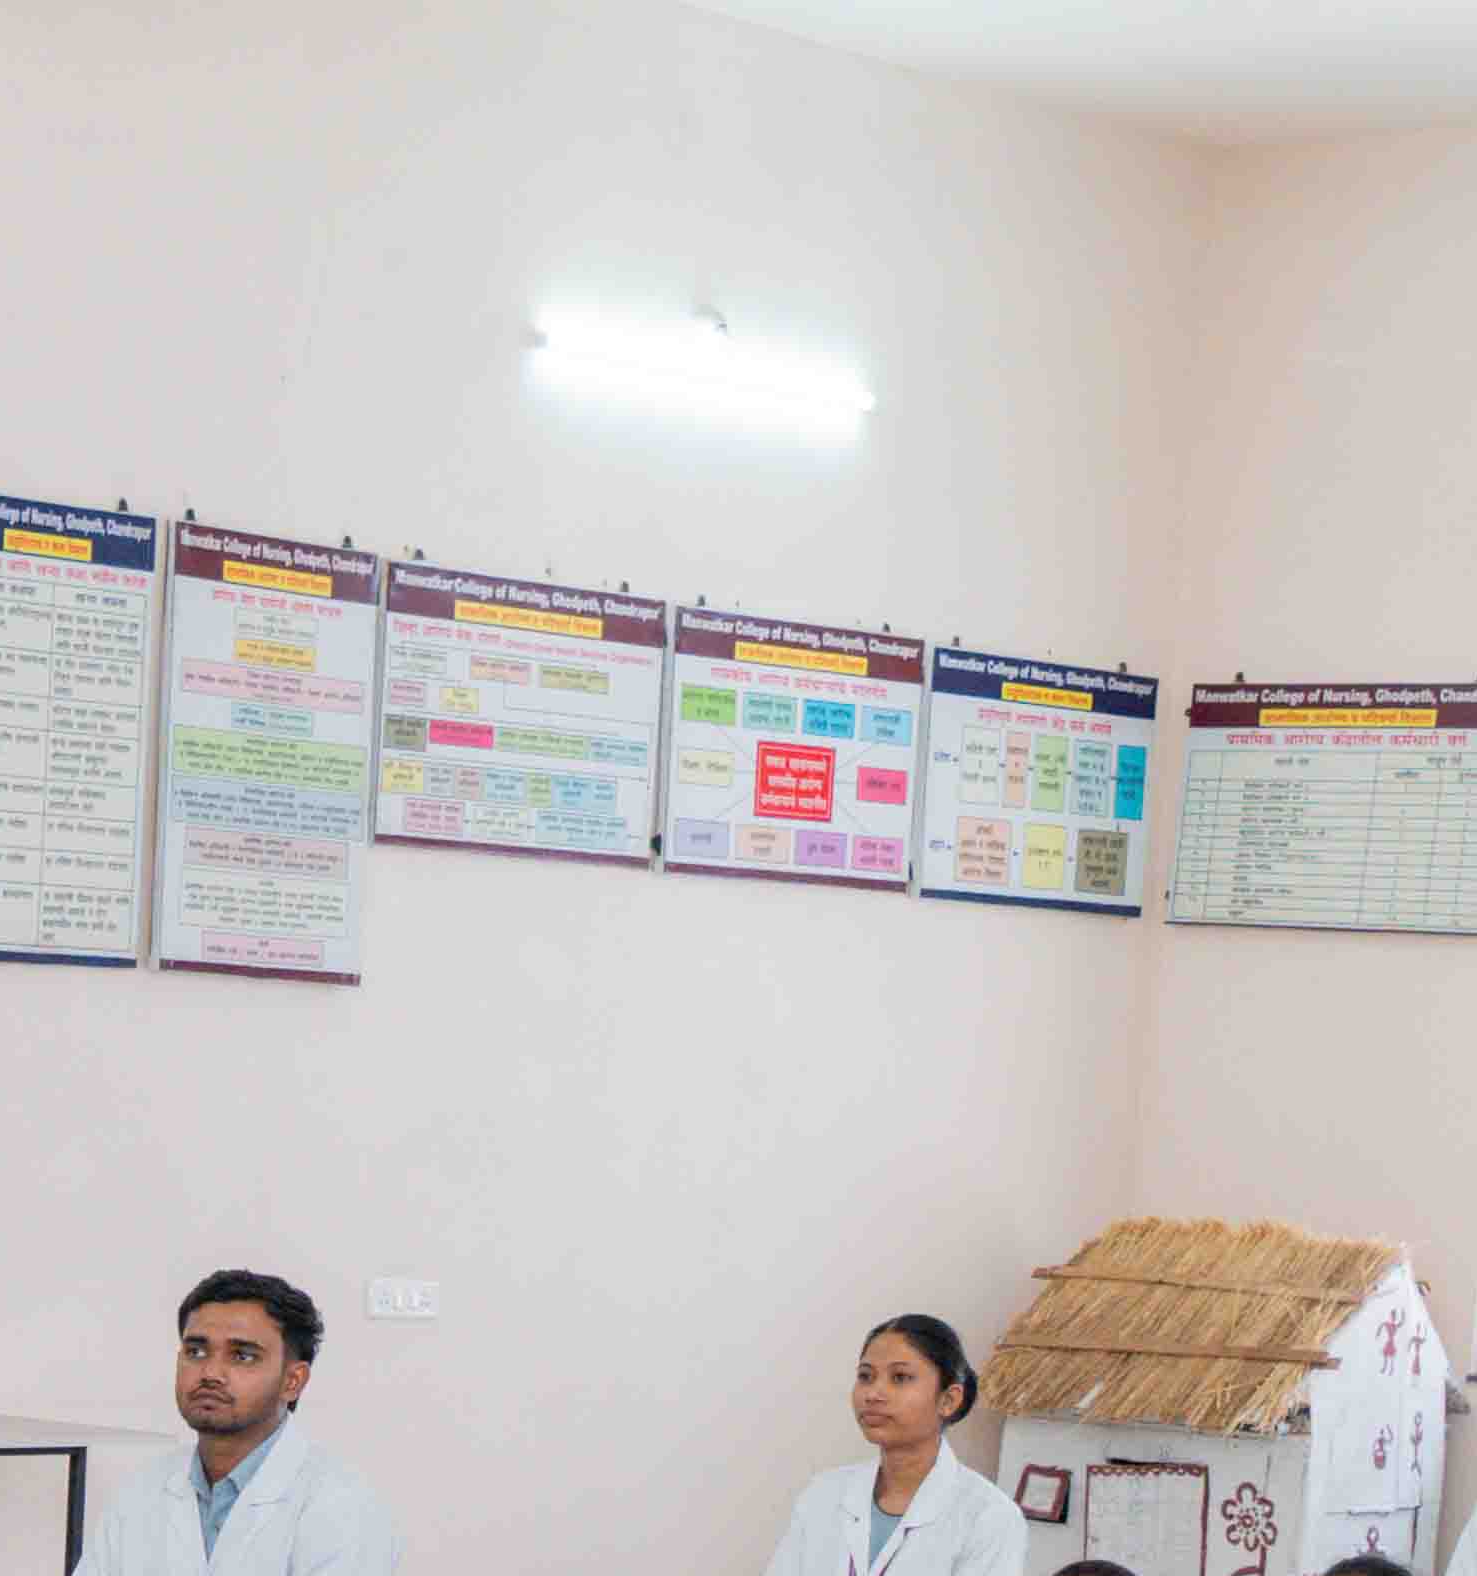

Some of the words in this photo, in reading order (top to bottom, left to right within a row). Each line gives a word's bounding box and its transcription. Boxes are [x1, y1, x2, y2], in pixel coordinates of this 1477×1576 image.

[22, 508, 29, 522] of
[496, 584, 507, 599] of
[772, 627, 781, 640] of
[1021, 665, 1029, 678] of
[1260, 688, 1304, 708] College
[1307, 688, 1319, 704] of
[1323, 688, 1374, 707] Nursing,
